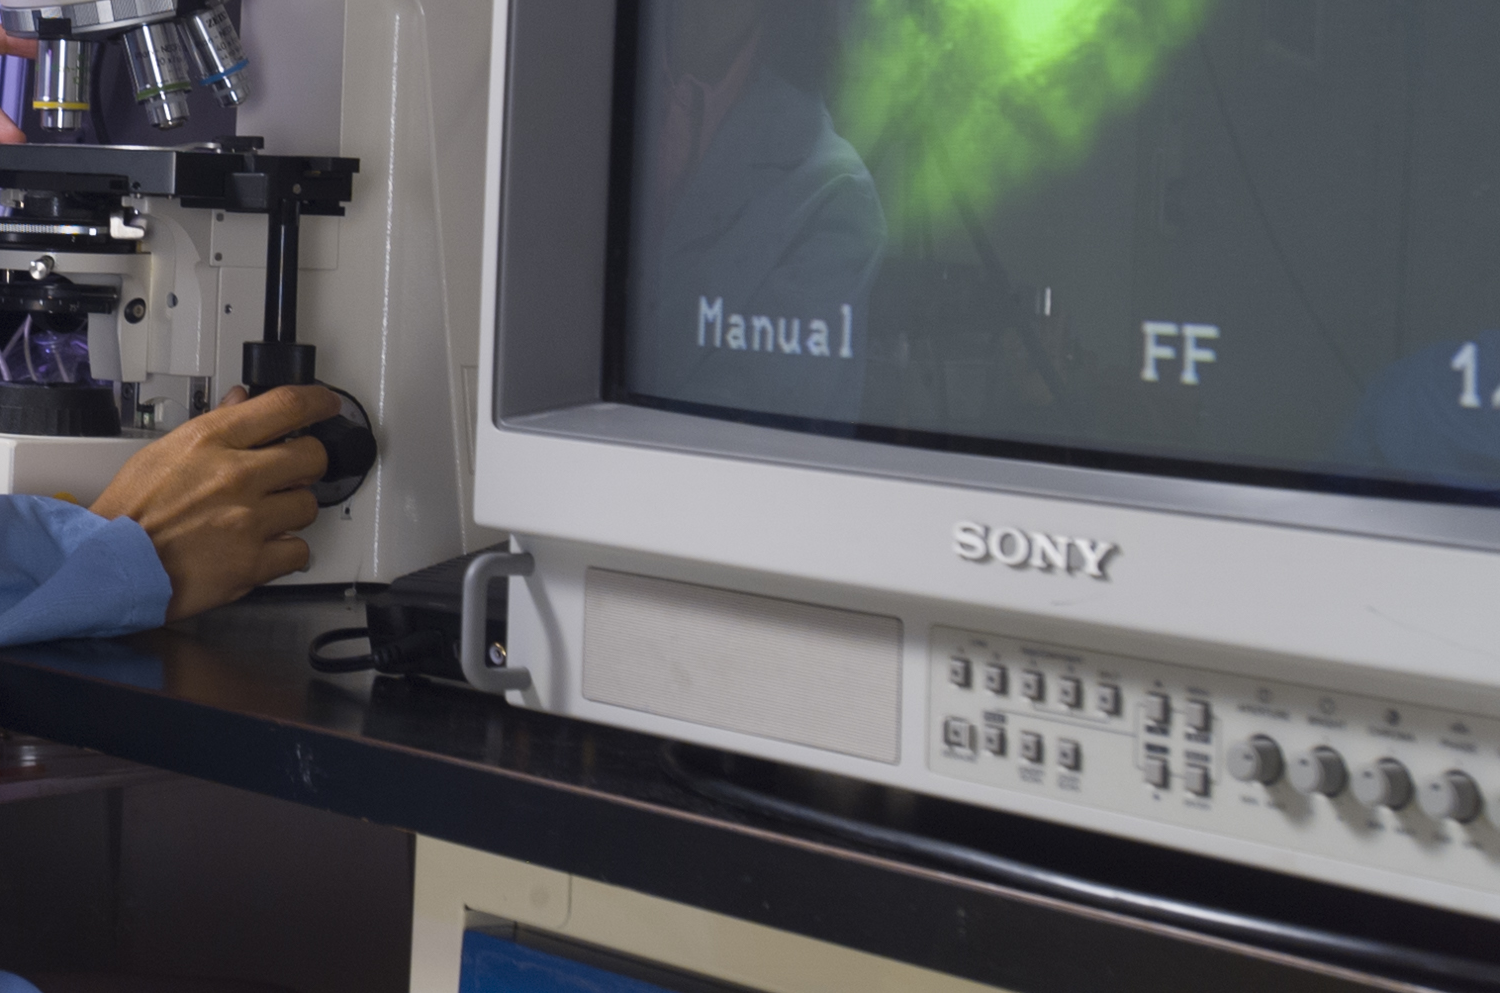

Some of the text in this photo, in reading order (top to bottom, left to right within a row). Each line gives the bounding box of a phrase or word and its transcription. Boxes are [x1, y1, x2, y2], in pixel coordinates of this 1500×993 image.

[697, 295, 1500, 409] Manual FF 1
[952, 520, 1116, 579] SONY
